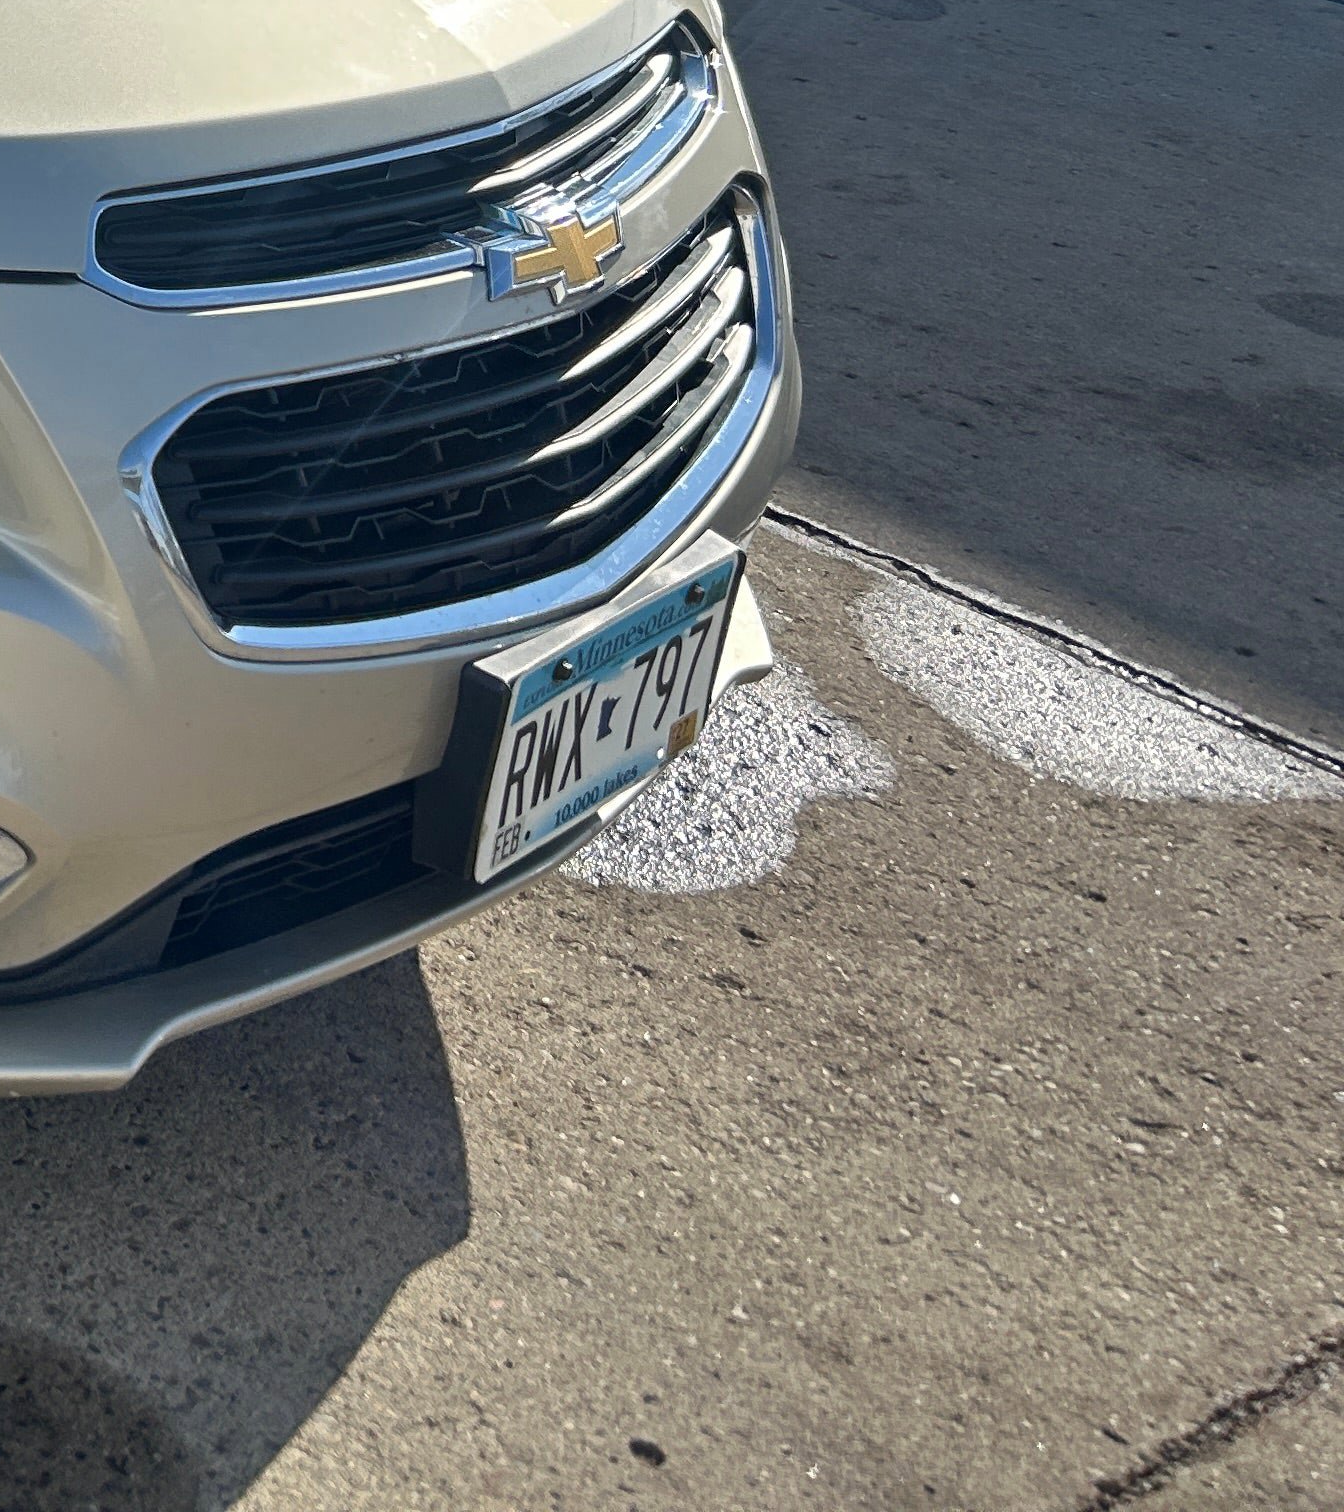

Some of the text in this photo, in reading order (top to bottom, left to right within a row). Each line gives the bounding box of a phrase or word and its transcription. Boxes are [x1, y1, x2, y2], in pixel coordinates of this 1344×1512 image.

[498, 615, 713, 828] RWX 797
[602, 765, 638, 798] lakes
[491, 822, 521, 869] FEB
